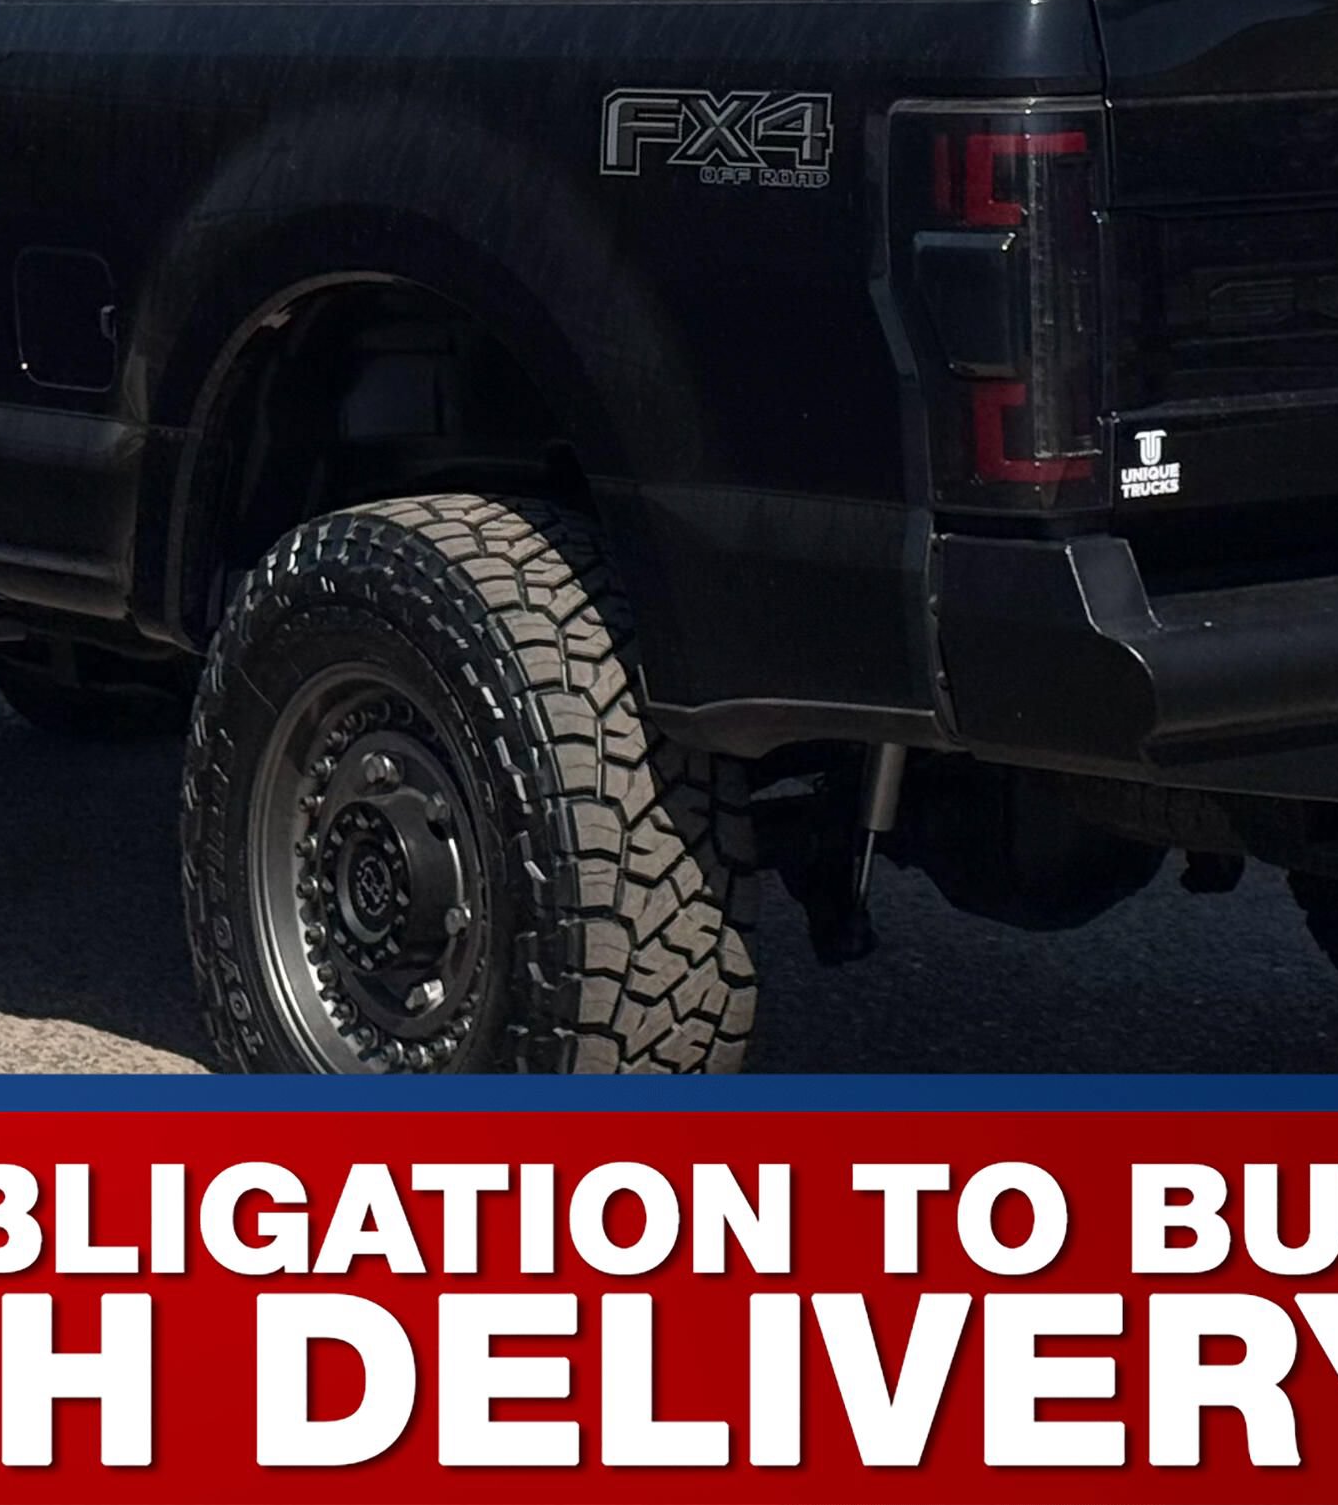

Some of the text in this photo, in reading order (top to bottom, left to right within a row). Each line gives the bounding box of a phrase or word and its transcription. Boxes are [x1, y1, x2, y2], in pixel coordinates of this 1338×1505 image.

[600, 88, 834, 175] FX4
[699, 166, 831, 188] OFF ROAD
[1120, 462, 1181, 484] UNIQUE
[1120, 478, 1180, 499] TRUCKS
[212, 914, 264, 1058] TOYO
